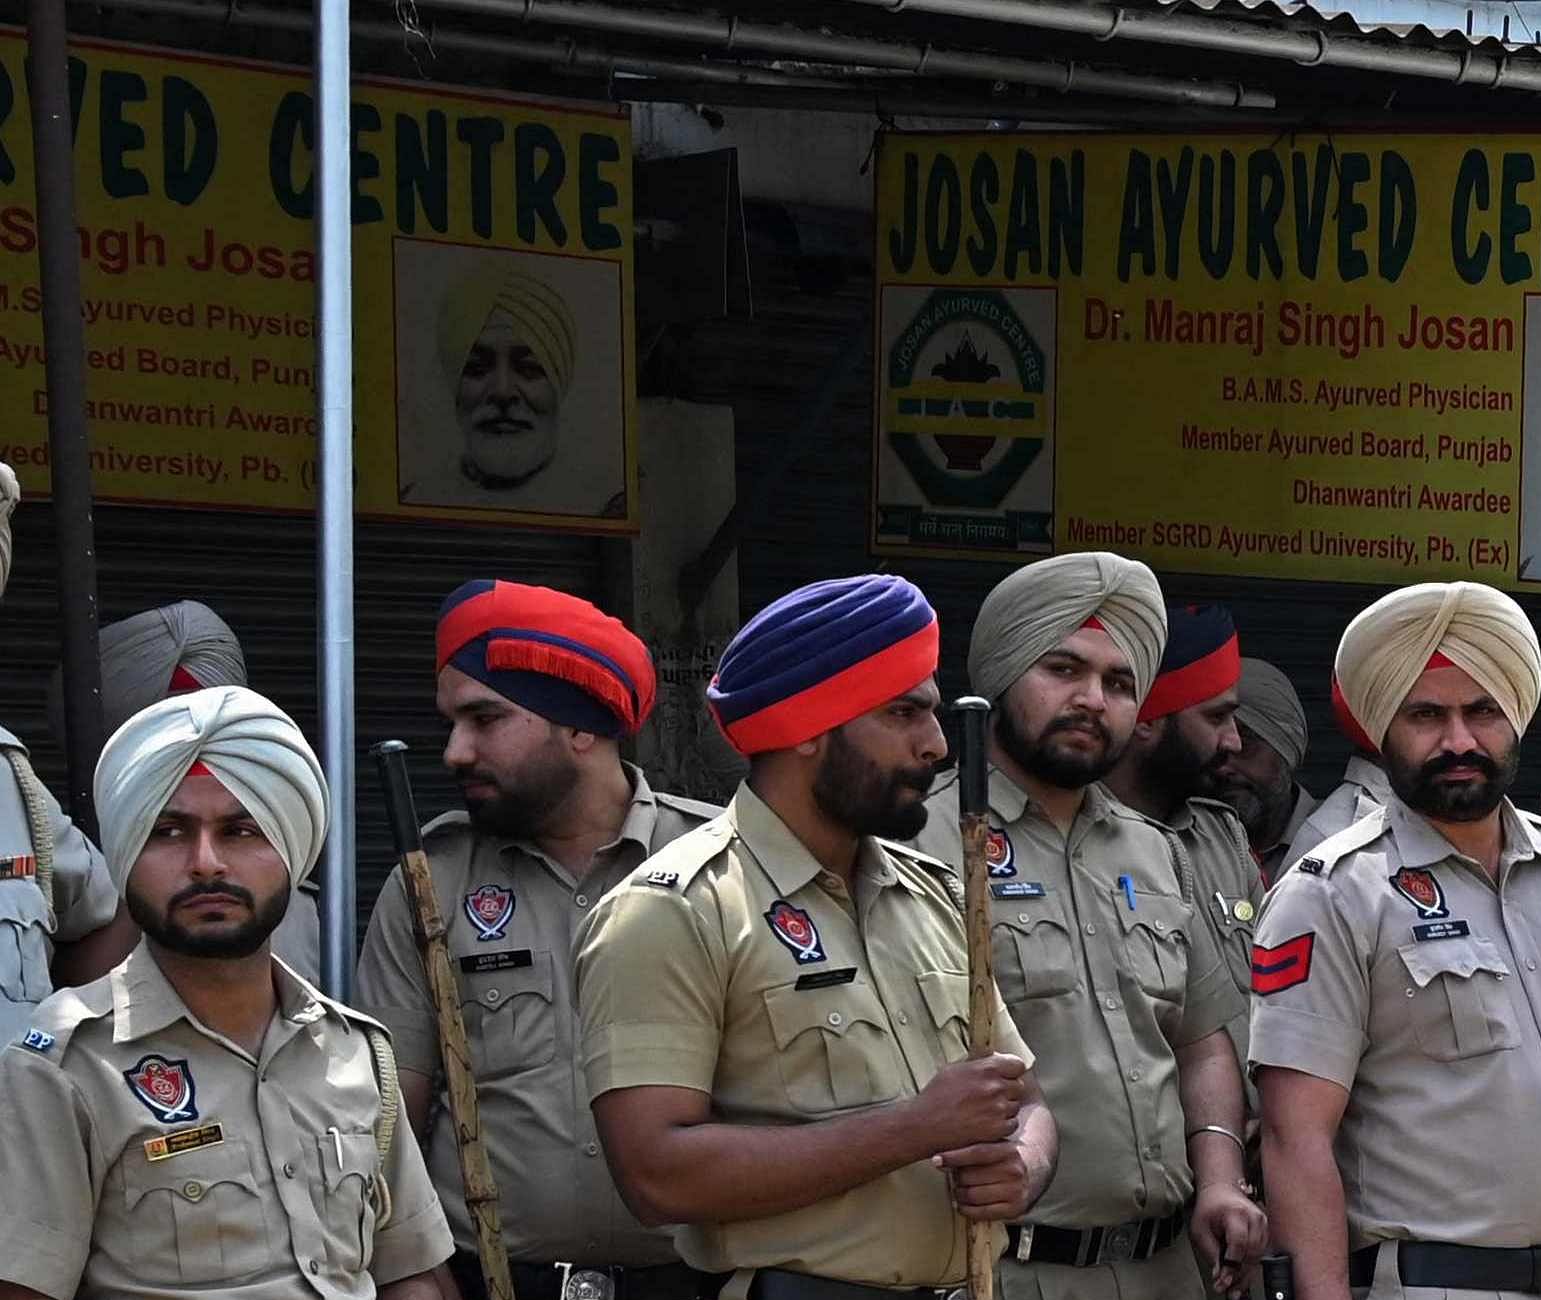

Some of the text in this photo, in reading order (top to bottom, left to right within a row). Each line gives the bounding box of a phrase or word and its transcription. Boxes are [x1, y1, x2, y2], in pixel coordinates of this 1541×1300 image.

[270, 90, 623, 250] CENTRE
[889, 147, 1086, 281] JOSAN
[1117, 144, 1417, 283] AYURVED
[1, 206, 318, 283] Sngh Josa
[80, 302, 354, 340] yurved Physici
[1084, 299, 1514, 359] Dr. Manraj Singh Josan
[0, 335, 124, 371] Ayued
[137, 350, 239, 382] Board,
[33, 390, 215, 428] Danwantri
[1223, 377, 1513, 414] B.A.M.S. Ayurved Physician
[88, 447, 229, 481] niversity,
[241, 457, 289, 483] Pb.
[1182, 424, 1513, 468] Member Ayurved Board, Punjab
[1294, 480, 1511, 514] Dhanwantri Awardee
[1068, 518, 1510, 570] Member SGRD Ayurved University, Pb. (Ex)
[25, 1028, 55, 1049] PP
